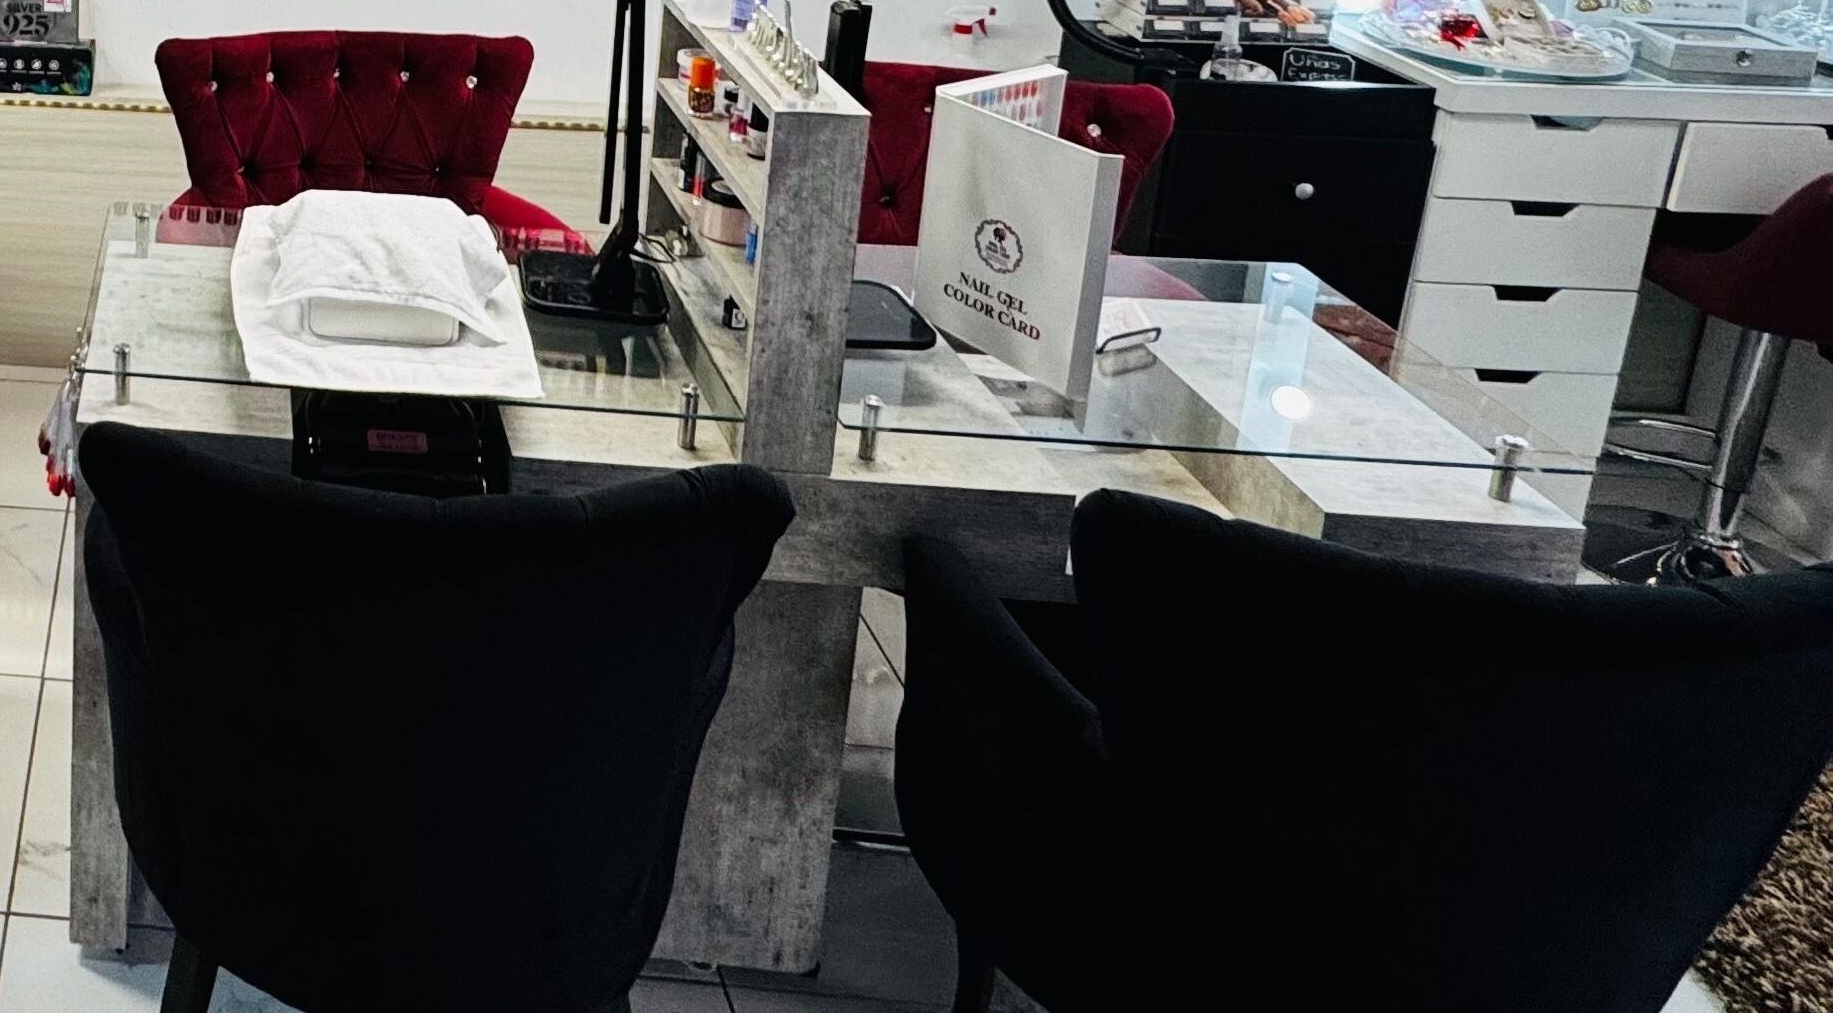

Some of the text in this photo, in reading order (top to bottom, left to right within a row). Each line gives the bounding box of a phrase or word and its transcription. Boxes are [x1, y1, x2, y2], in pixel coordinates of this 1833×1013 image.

[6, 2, 42, 14] SILVER
[3, 14, 50, 37] 925
[959, 271, 1028, 315] NAIL GEL
[943, 283, 1041, 341] COLOR CARD
